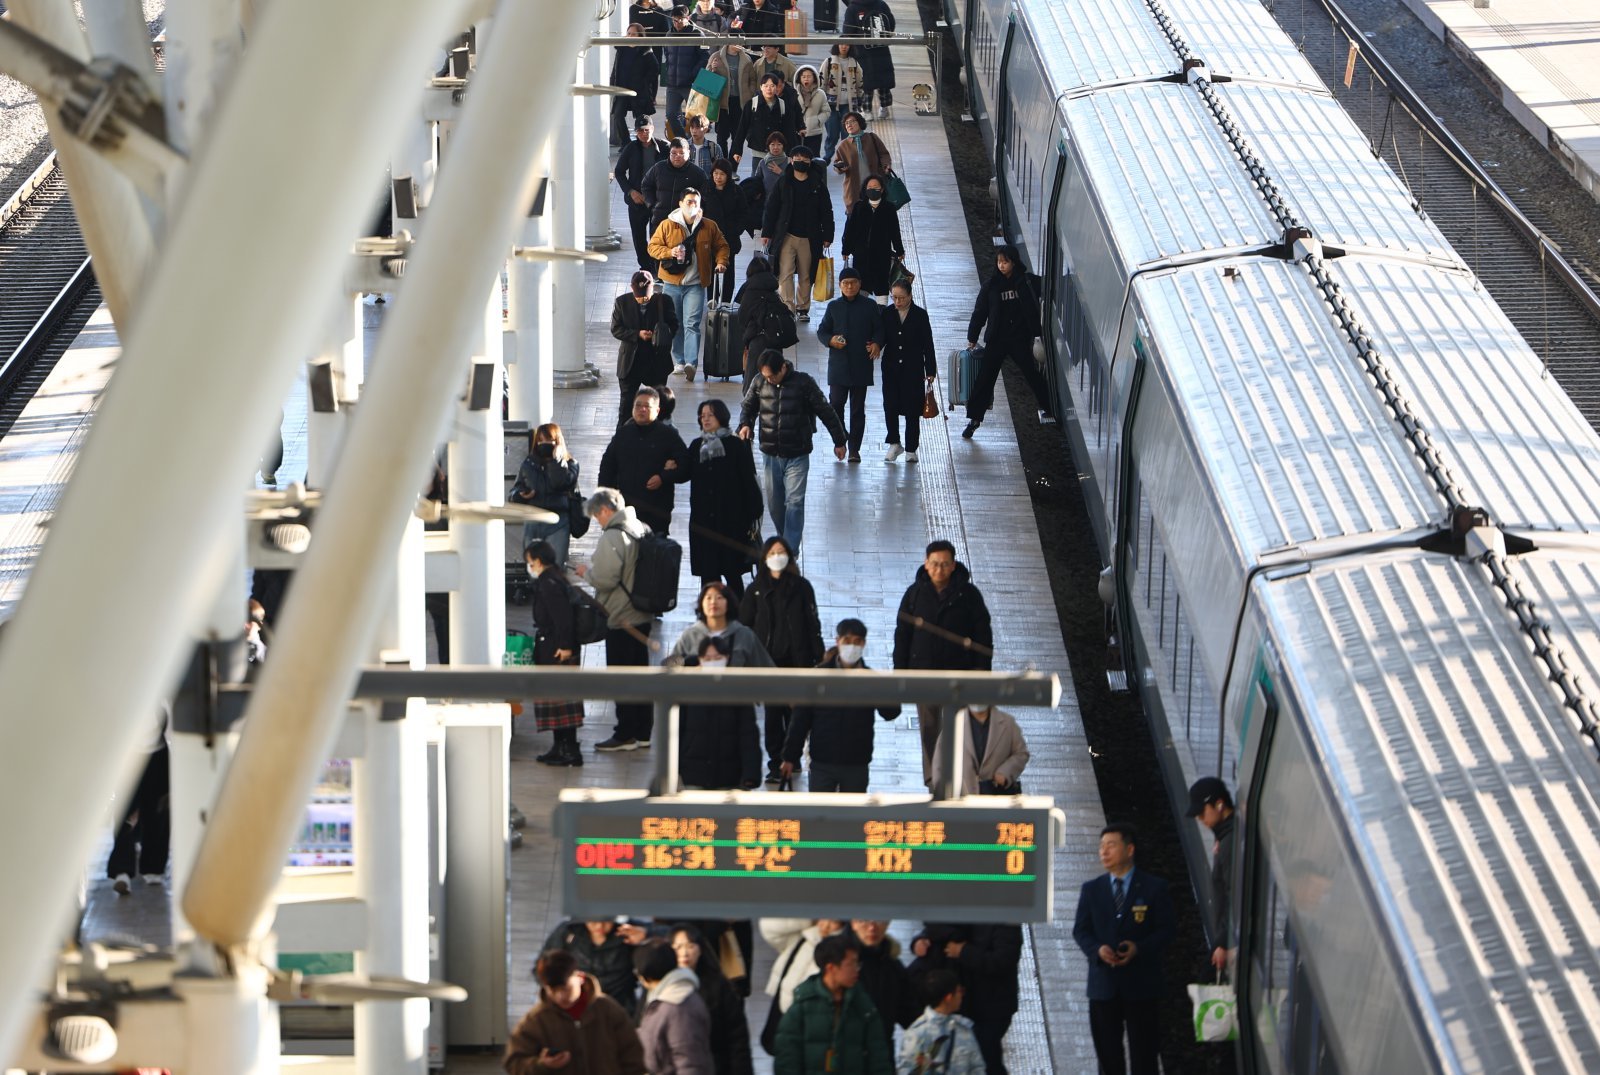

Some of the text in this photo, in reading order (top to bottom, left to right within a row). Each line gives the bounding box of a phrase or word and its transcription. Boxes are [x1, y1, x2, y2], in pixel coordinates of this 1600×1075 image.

[640, 817, 1034, 847] 도착시간 출발역 열차종류 지연
[576, 842, 1024, 874] 이번 16:34 부산 KTX 0
